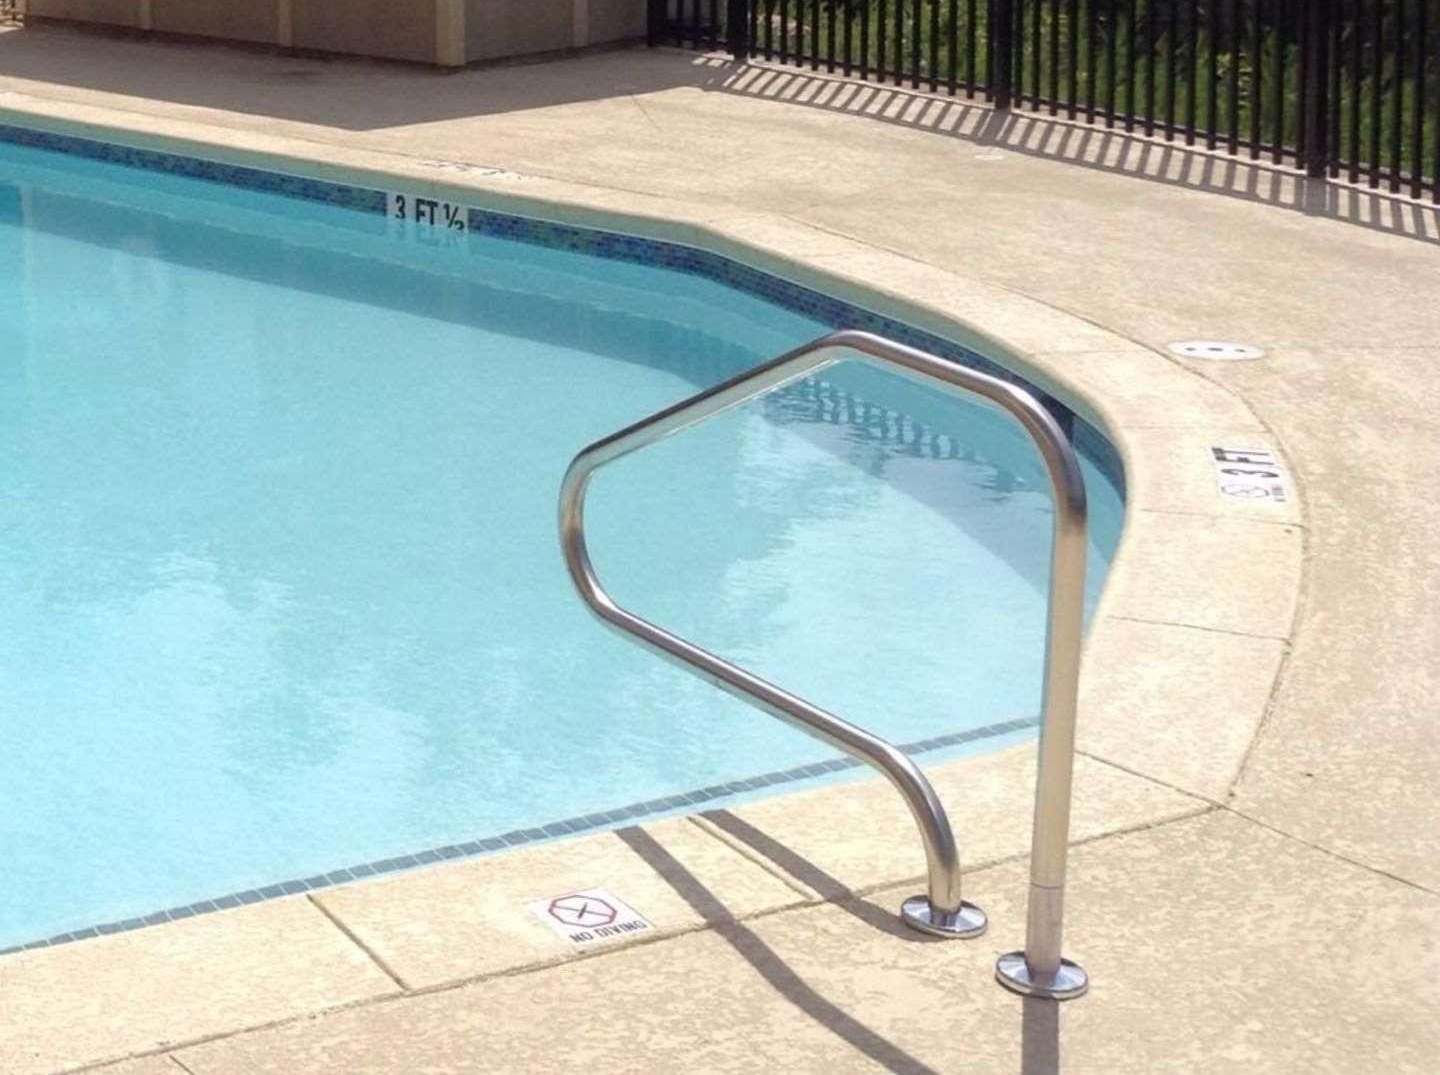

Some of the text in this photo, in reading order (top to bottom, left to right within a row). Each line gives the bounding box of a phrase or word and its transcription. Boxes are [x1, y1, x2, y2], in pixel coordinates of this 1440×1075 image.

[395, 194, 406, 219] 3
[415, 198, 438, 225] FT
[1211, 447, 1275, 466] FT
[568, 919, 648, 943] NO DIVING
